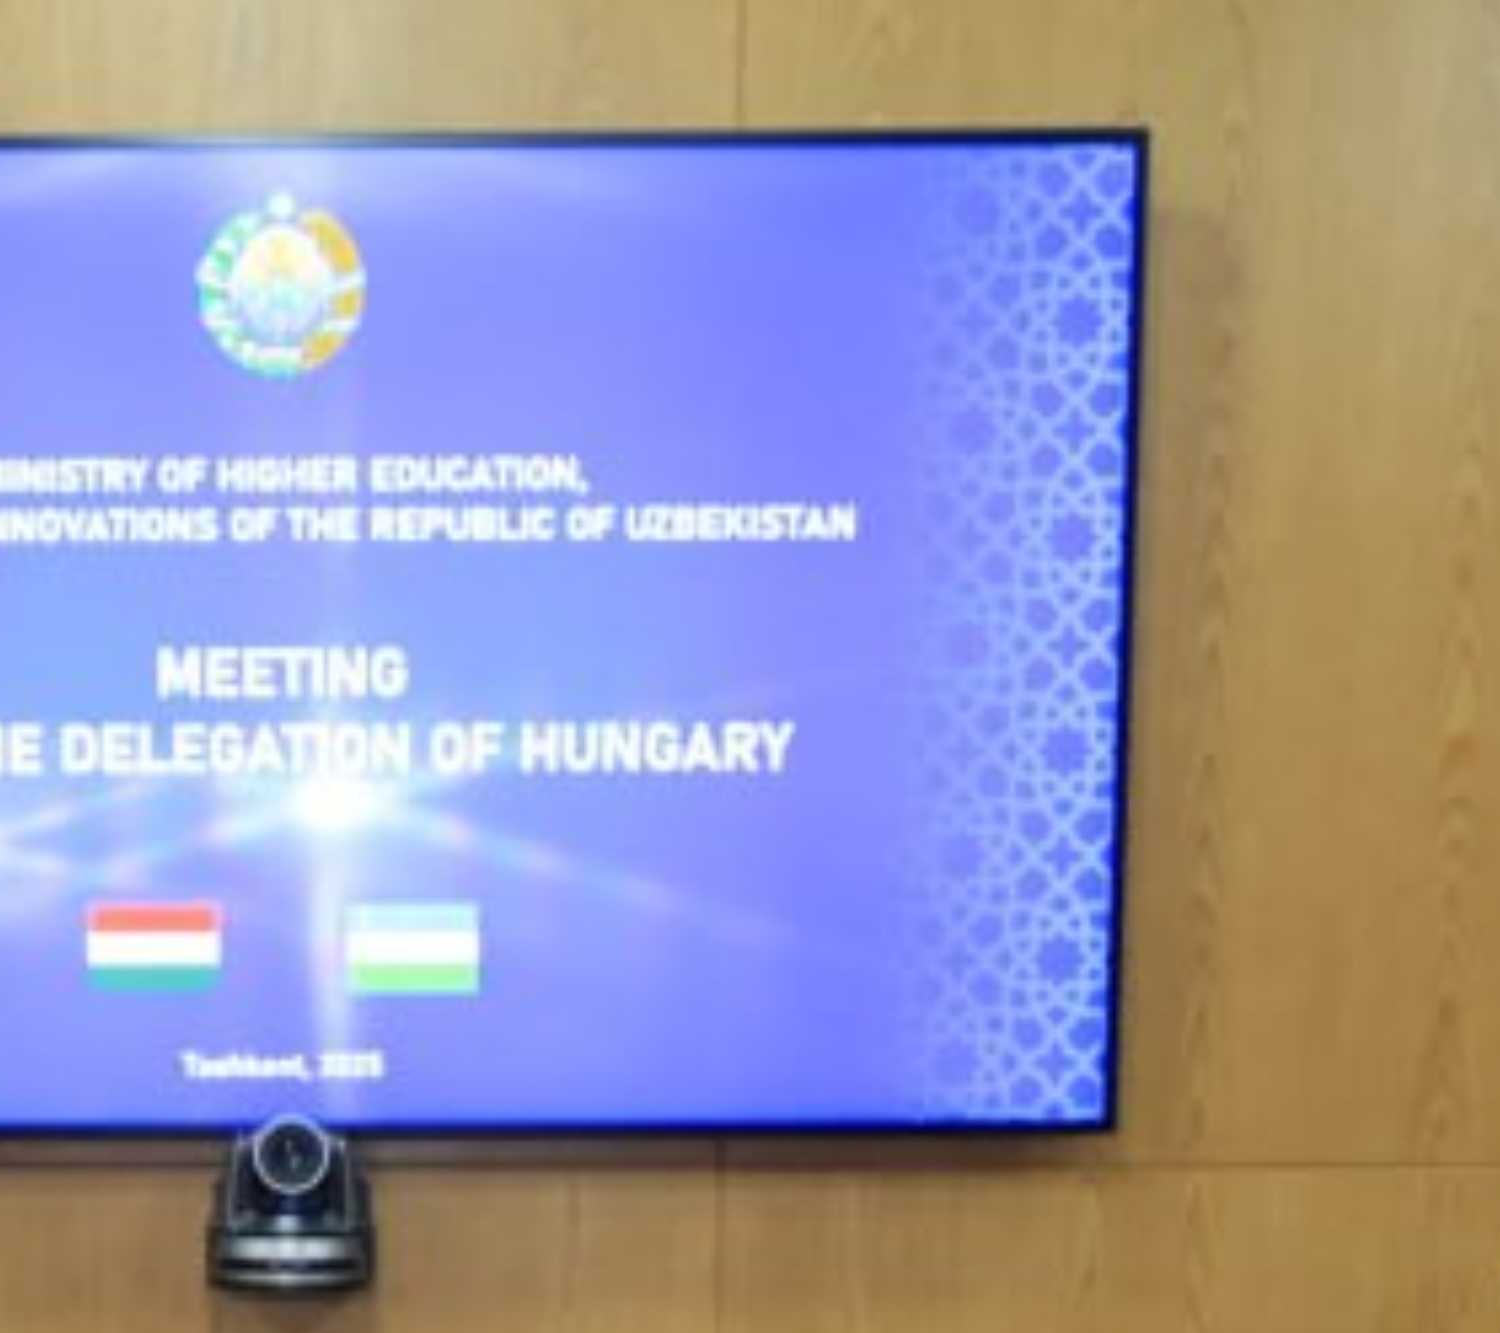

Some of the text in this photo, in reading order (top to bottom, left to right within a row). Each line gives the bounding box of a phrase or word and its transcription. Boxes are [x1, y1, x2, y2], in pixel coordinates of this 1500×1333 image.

[156, 457, 207, 493] OF
[217, 456, 356, 492] HIGHER
[370, 454, 590, 494] EDUCATION,
[230, 506, 277, 541] OF
[286, 505, 357, 541] THE
[370, 505, 556, 541] REPUBLIC
[565, 504, 615, 541] OF
[625, 502, 856, 541] UZBEKISTAN
[156, 645, 409, 698] MEETING
[60, 720, 411, 774] DELEGATION
[428, 721, 503, 772] OF
[521, 720, 796, 773] HUNGARY
